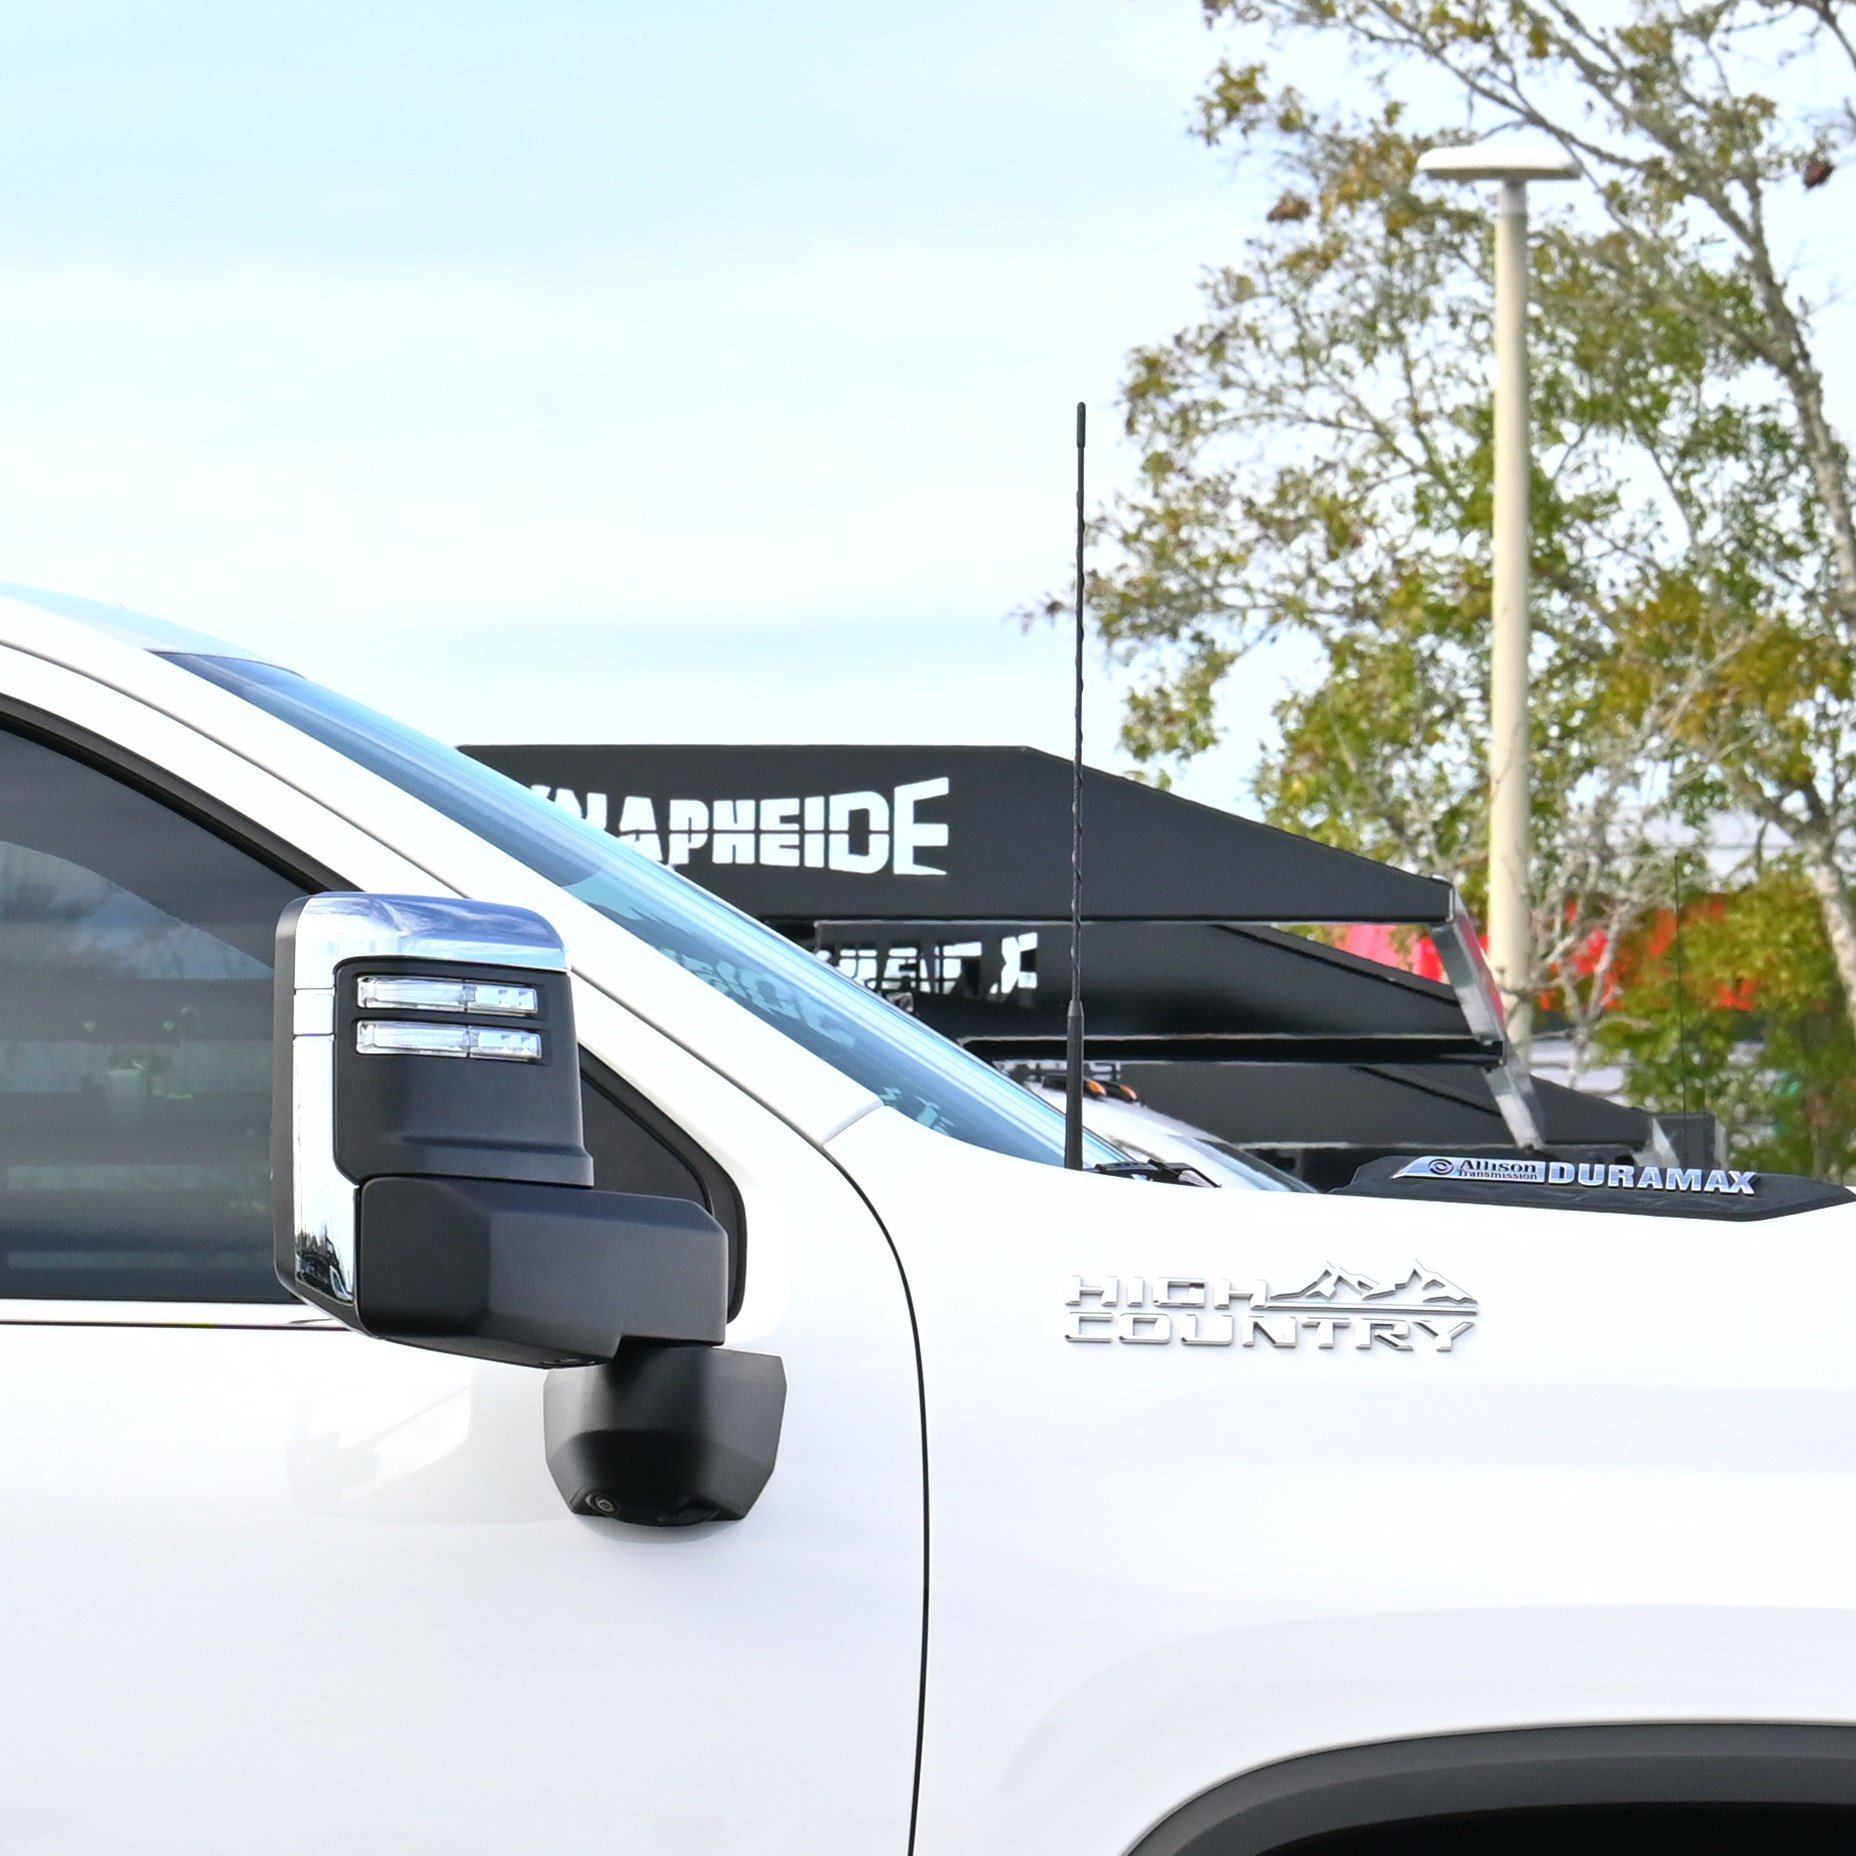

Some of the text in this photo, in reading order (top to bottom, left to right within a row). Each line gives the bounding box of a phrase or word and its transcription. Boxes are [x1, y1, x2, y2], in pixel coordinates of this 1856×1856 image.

[531, 776, 949, 876] NAPHEIDE
[1457, 1170, 1538, 1181] Transmission
[1460, 1159, 1537, 1173] Allison
[1548, 1161, 1757, 1195] DURAMAX
[1065, 1275, 1270, 1310] HIGH
[1064, 1311, 1476, 1352] COUNTRY
